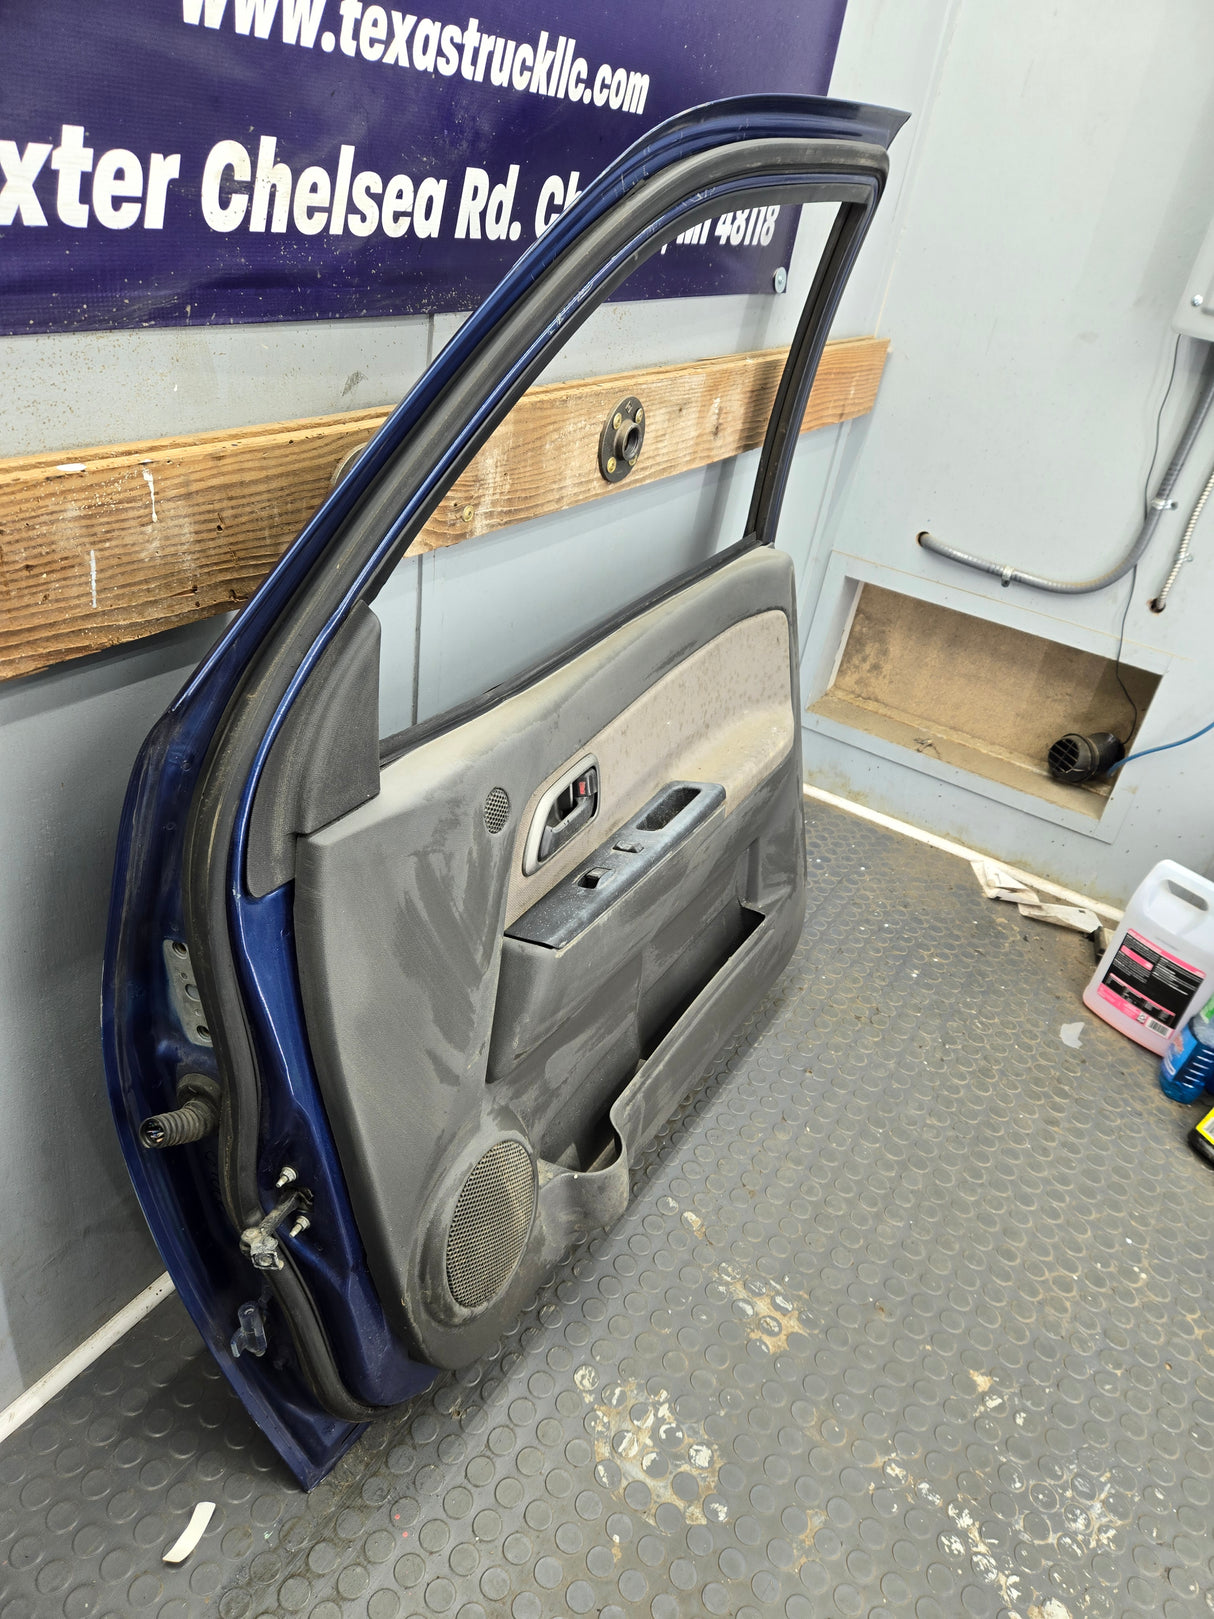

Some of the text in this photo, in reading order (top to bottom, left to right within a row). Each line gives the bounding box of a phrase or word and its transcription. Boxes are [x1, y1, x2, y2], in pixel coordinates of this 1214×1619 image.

[0, 124, 181, 230] xter
[201, 135, 448, 238] Chelsea
[454, 164, 522, 241] Rd.
[714, 205, 780, 246] 48118
